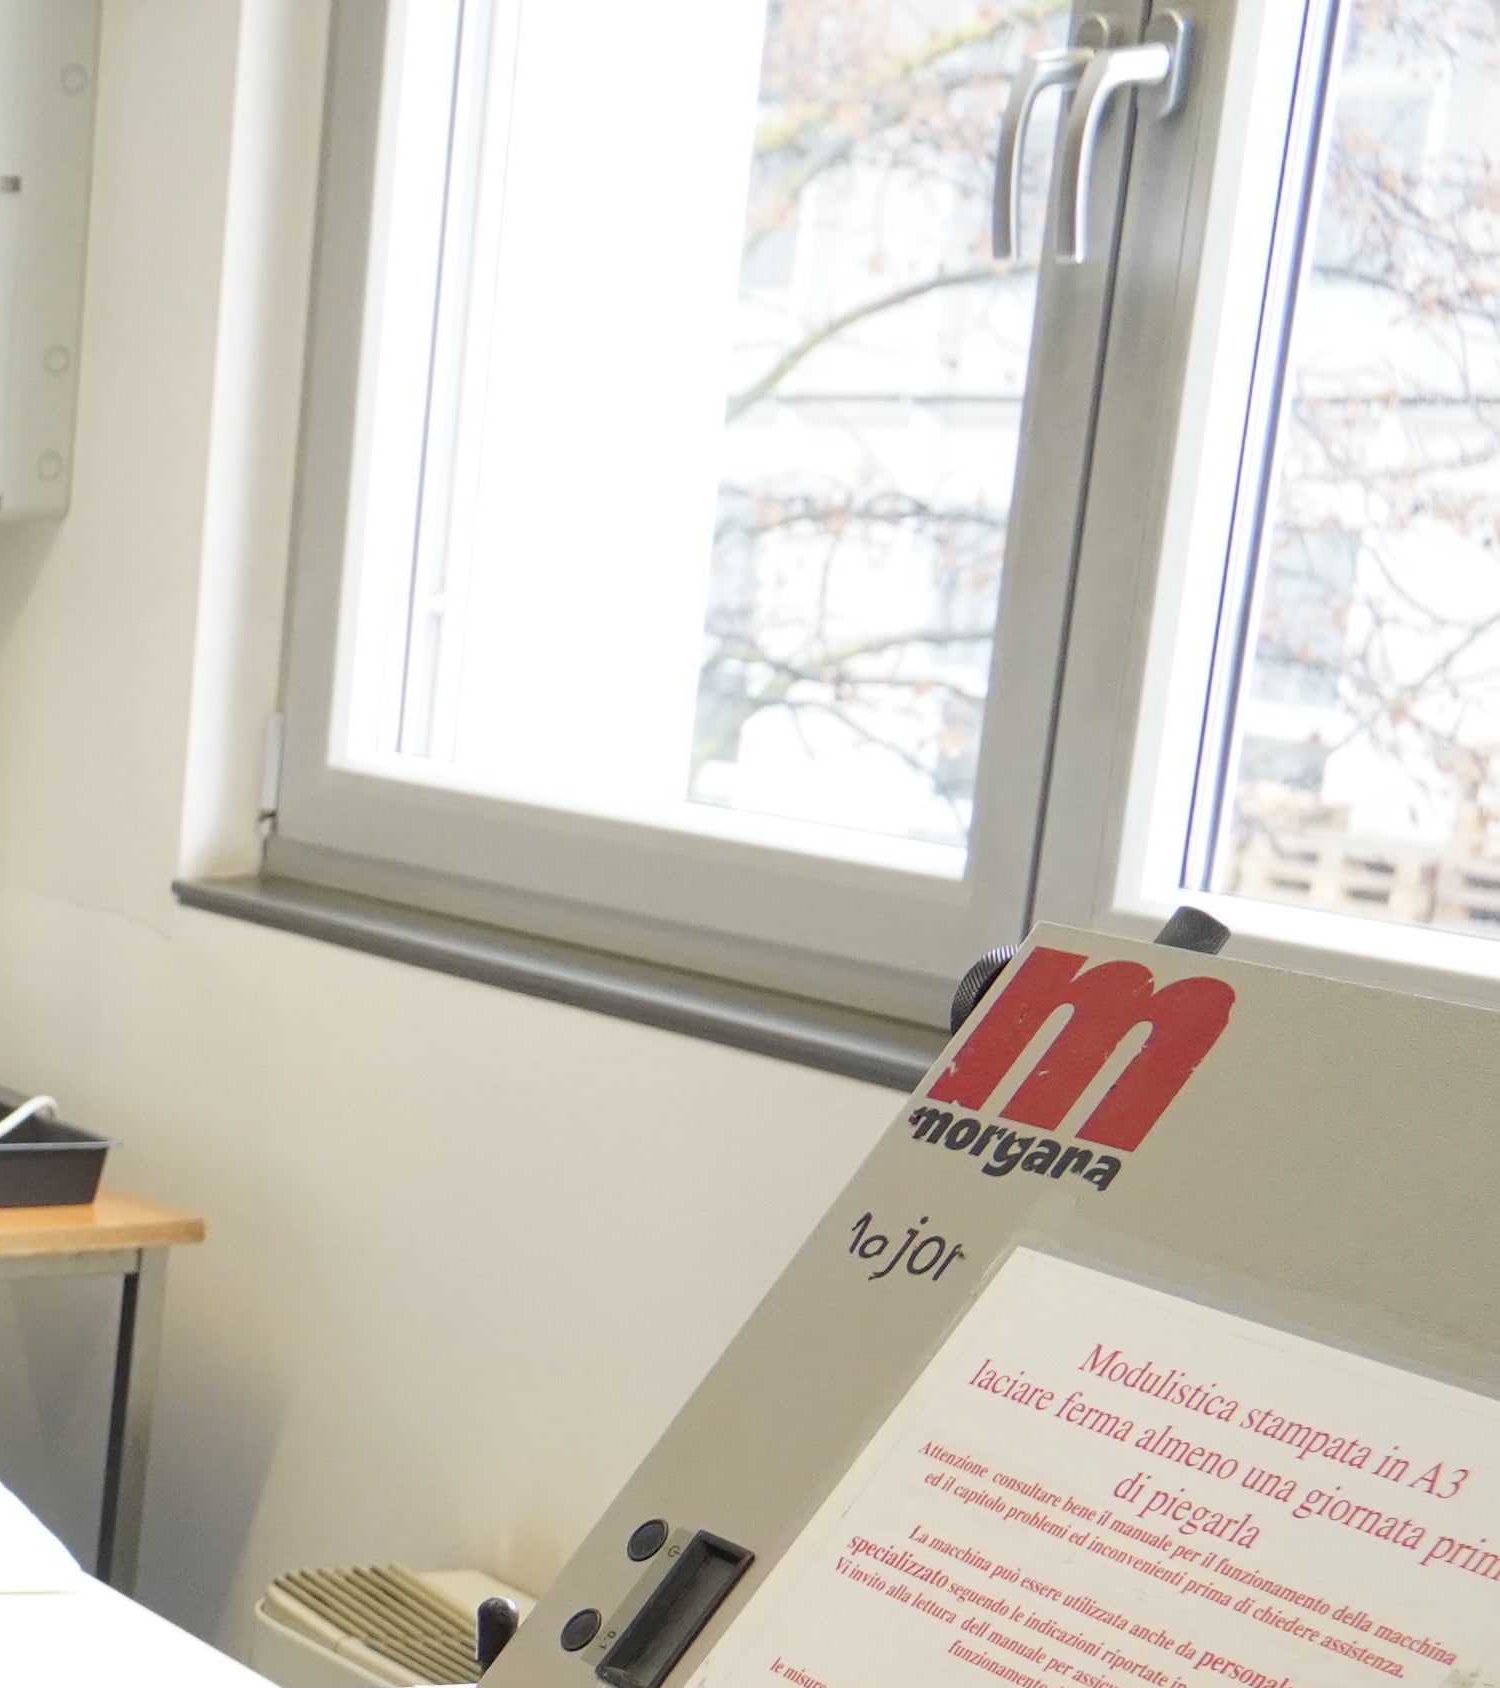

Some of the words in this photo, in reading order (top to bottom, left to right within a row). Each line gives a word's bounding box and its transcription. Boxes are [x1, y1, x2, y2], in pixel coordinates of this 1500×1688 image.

[908, 1105, 1123, 1192] morgana
[848, 1211, 968, 1283] ajor
[968, 1358, 1055, 1411] laciare
[1054, 1391, 1134, 1442] ferma
[1134, 1425, 1239, 1480] almeno
[1241, 1466, 1297, 1503] una
[1291, 1486, 1426, 1550] giornata
[1077, 1343, 1239, 1422] Modulistica
[1239, 1408, 1372, 1470] stampata
[1372, 1446, 1410, 1483] in
[1408, 1462, 1469, 1499] A3
[917, 1438, 989, 1478] Attenzione
[991, 1473, 1063, 1508] consultare
[1061, 1496, 1098, 1521] bene
[1095, 1510, 1113, 1528] il
[1109, 1517, 1174, 1555] manuale
[1170, 1541, 1203, 1565] per
[1199, 1551, 1218, 1569] il
[1213, 1557, 1332, 1615] funzionamento
[1331, 1604, 1374, 1634] della
[1373, 1625, 1458, 1667] macchina
[924, 1474, 944, 1486] ed
[941, 1477, 957, 1491] il
[952, 1487, 1007, 1512] capitolo
[1003, 1506, 1069, 1538] problemi
[1068, 1532, 1092, 1547] ed
[1086, 1540, 1186, 1586] inconvenienti
[1182, 1580, 1233, 1607] prima
[1232, 1597, 1255, 1614] di
[1250, 1606, 1320, 1642] chiedere
[1320, 1636, 1404, 1678] assistenza.
[1113, 1472, 1152, 1504] di
[1136, 1488, 1260, 1549] piegarla
[836, 1557, 850, 1574] Vi
[849, 1568, 887, 1591] invito
[886, 1585, 912, 1604] alla
[912, 1593, 957, 1624] lettura
[960, 1617, 990, 1637] dell
[988, 1631, 1047, 1664] manuale
[1043, 1657, 1074, 1675] per
[847, 1536, 950, 1588] specializzato
[949, 1582, 1010, 1616] seguendo
[1008, 1605, 1024, 1623] le
[1023, 1612, 1102, 1657] indicazioni
[1100, 1649, 1169, 1687] riportate
[908, 1525, 929, 1544] La
[928, 1538, 992, 1572] macchina
[988, 1565, 1020, 1583] può
[1020, 1577, 1062, 1602] essere
[1062, 1595, 1129, 1631] utilizzata
[1128, 1624, 1175, 1650] anche
[1174, 1641, 1197, 1660] da
[771, 1658, 784, 1672] le
